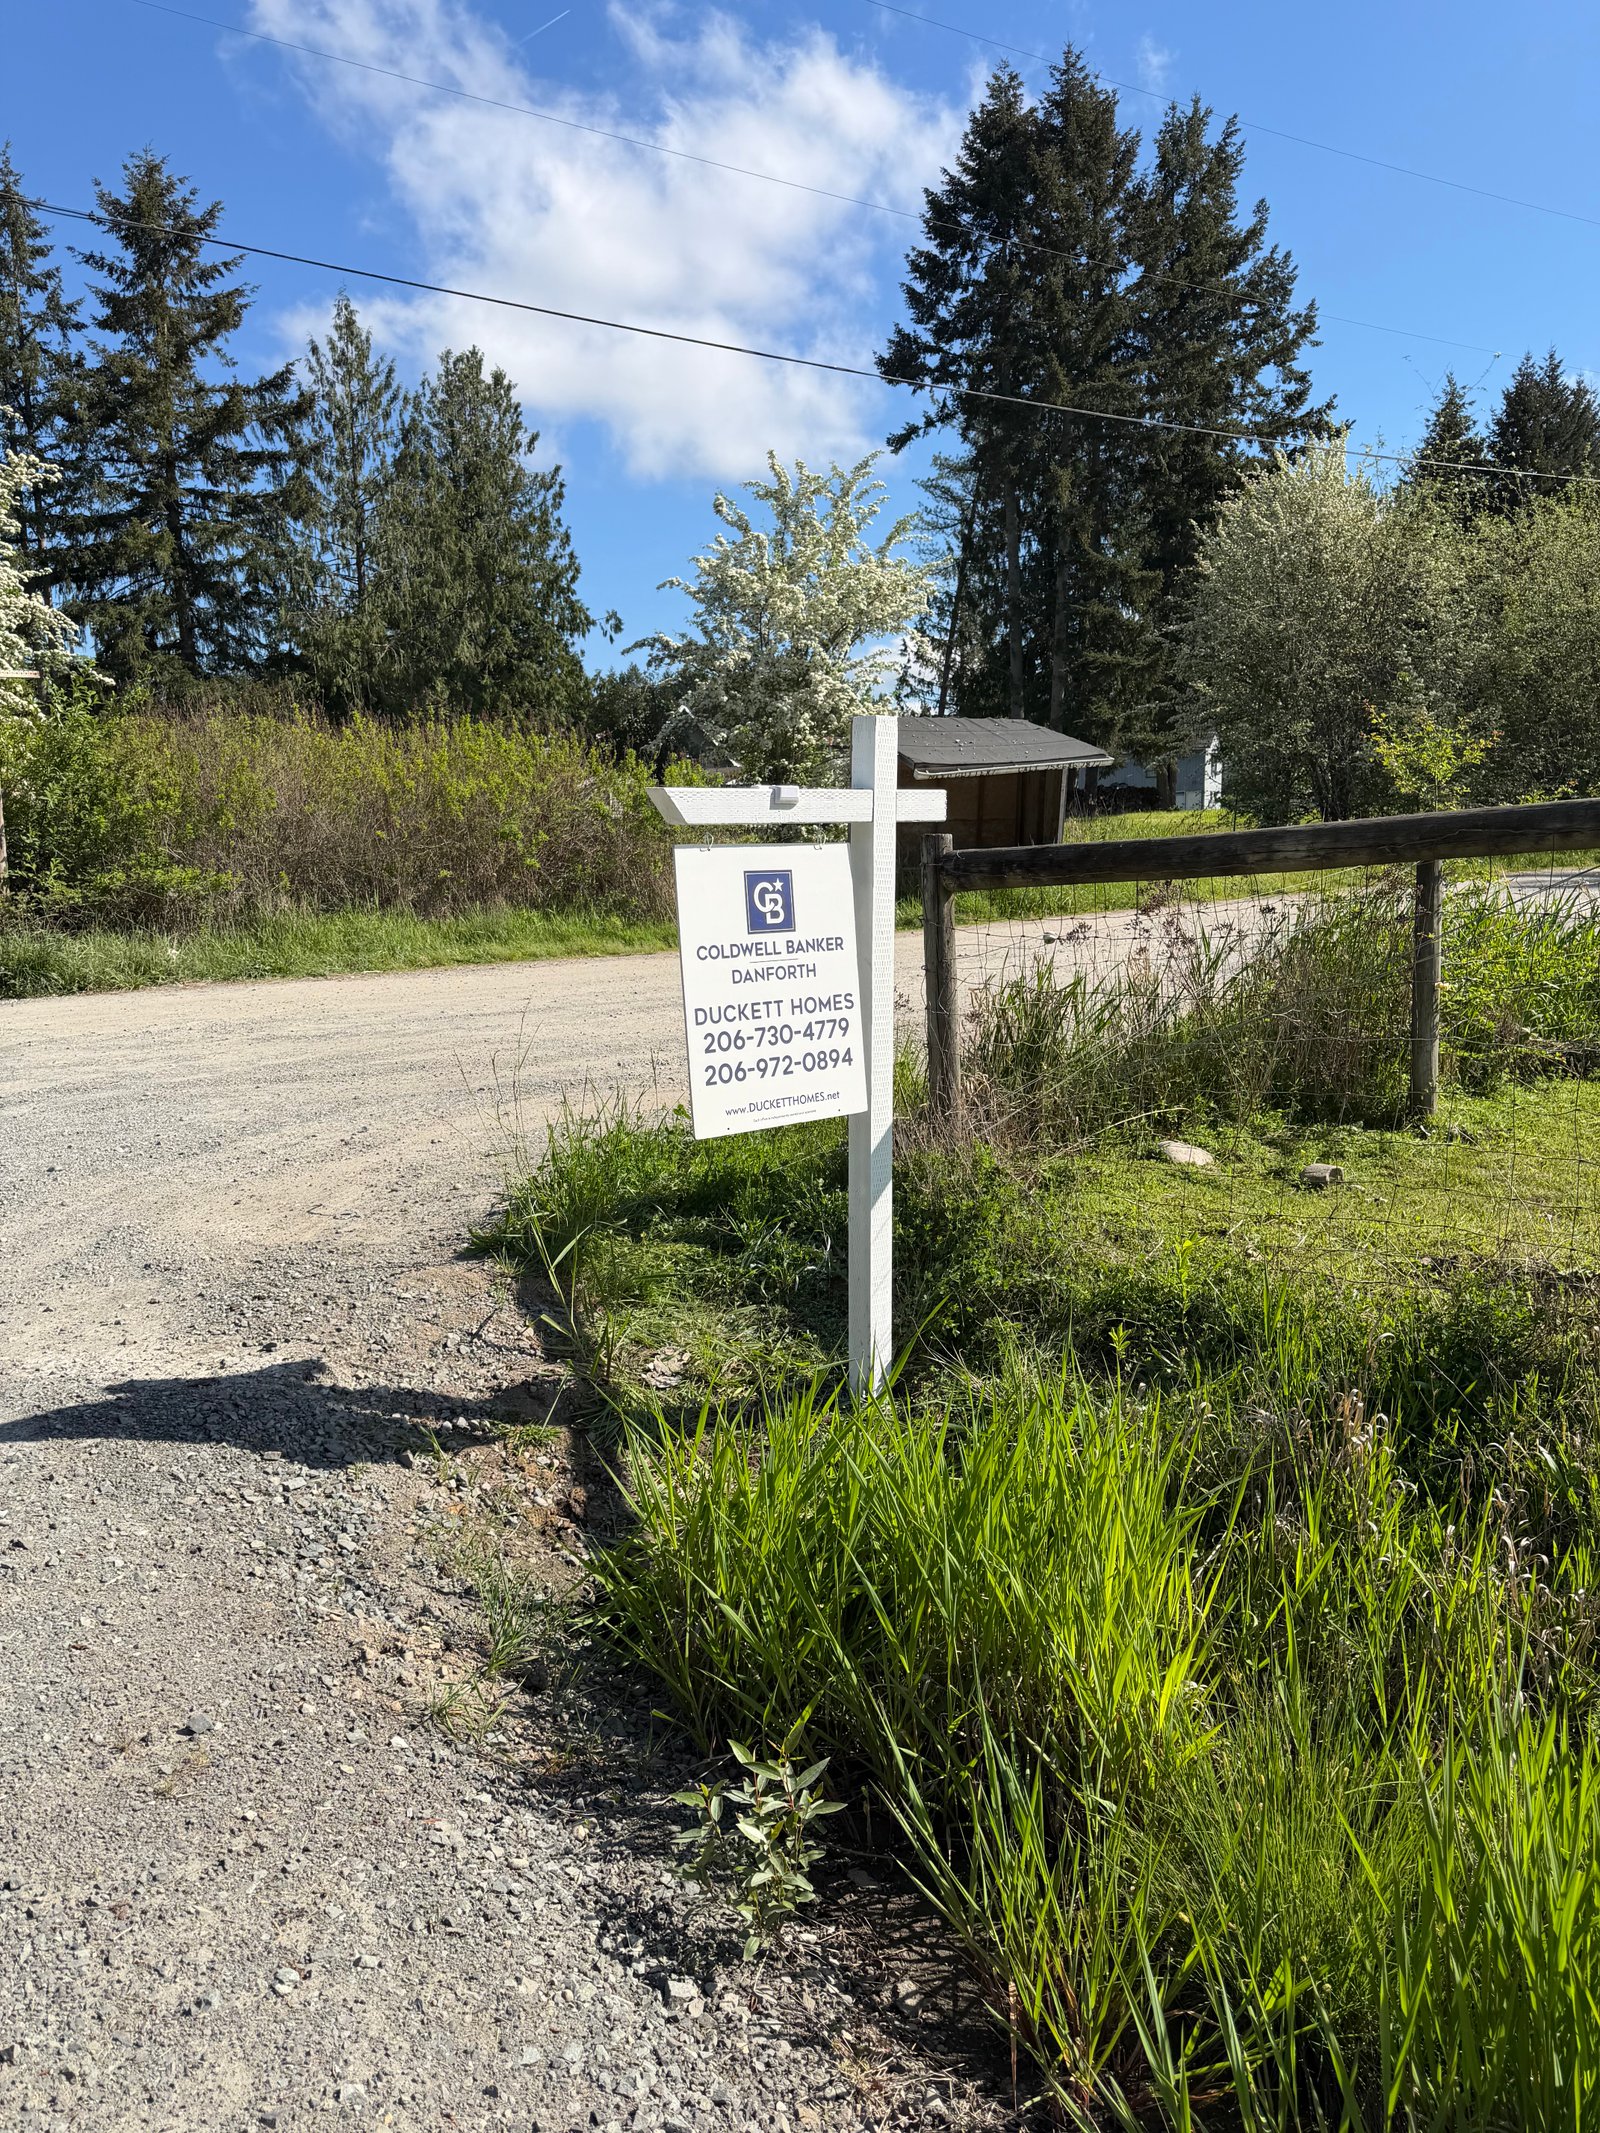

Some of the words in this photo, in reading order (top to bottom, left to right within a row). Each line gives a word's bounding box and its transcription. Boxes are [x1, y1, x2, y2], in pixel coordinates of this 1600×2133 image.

[697, 941, 782, 960] COLDWELL
[786, 937, 844, 954] BANKER
[732, 963, 817, 984] DANFORTH
[694, 1000, 784, 1026] DUCKETT
[791, 993, 854, 1015] HOMES
[704, 1018, 850, 1054] 206-730-4779
[704, 1047, 853, 1086] 206-972-0894
[725, 1091, 840, 1116] www.DUCKETTHOMES.net
